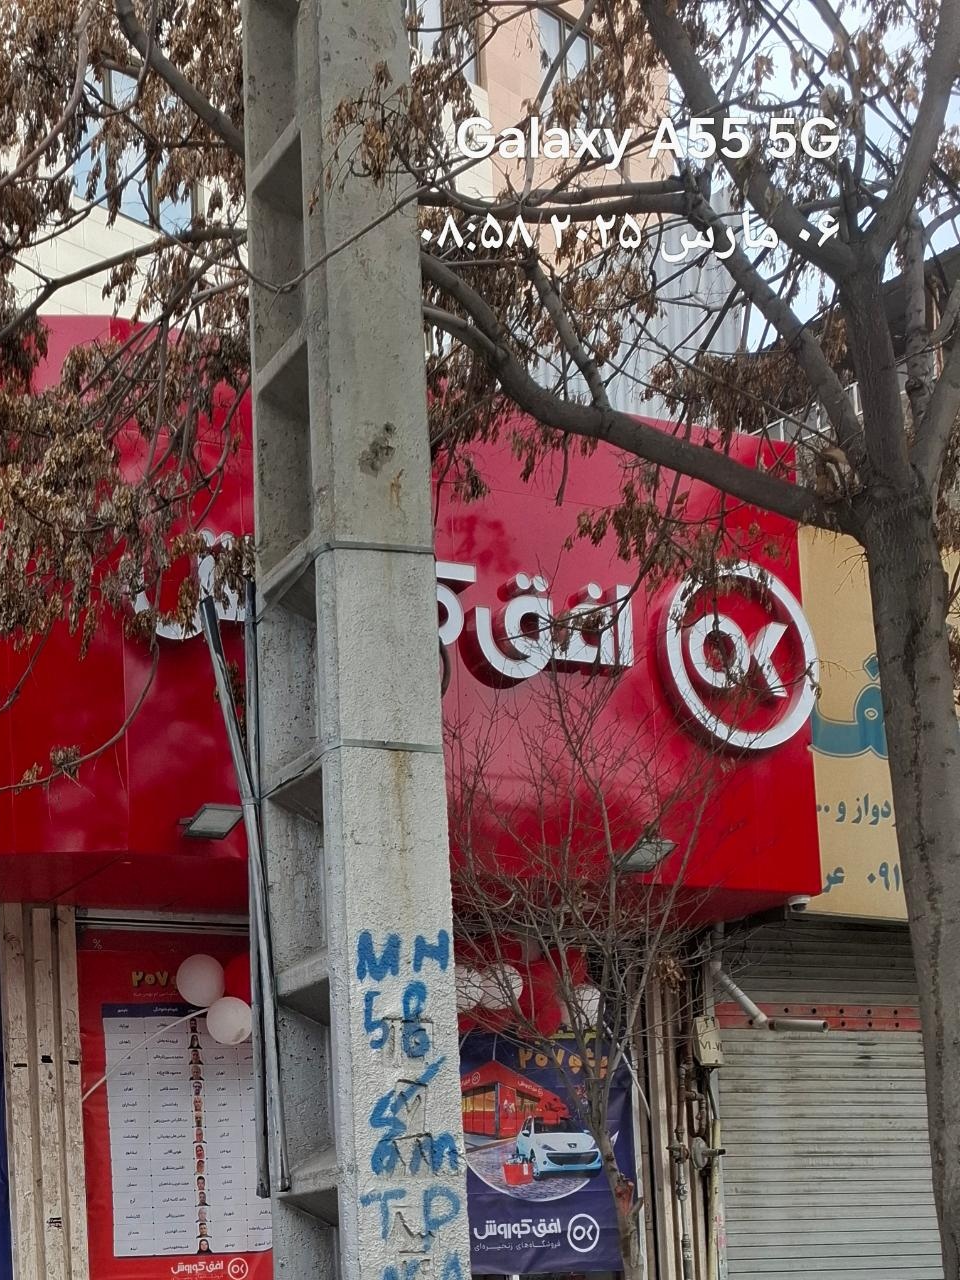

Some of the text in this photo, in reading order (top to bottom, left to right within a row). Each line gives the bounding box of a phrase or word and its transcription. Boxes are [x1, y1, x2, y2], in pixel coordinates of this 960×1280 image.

[476, 572, 634, 679] افق
[867, 862, 900, 892] ۰۹۱
[473, 1218, 562, 1240] افق کوروش
[171, 1260, 224, 1275] افق کوروش
